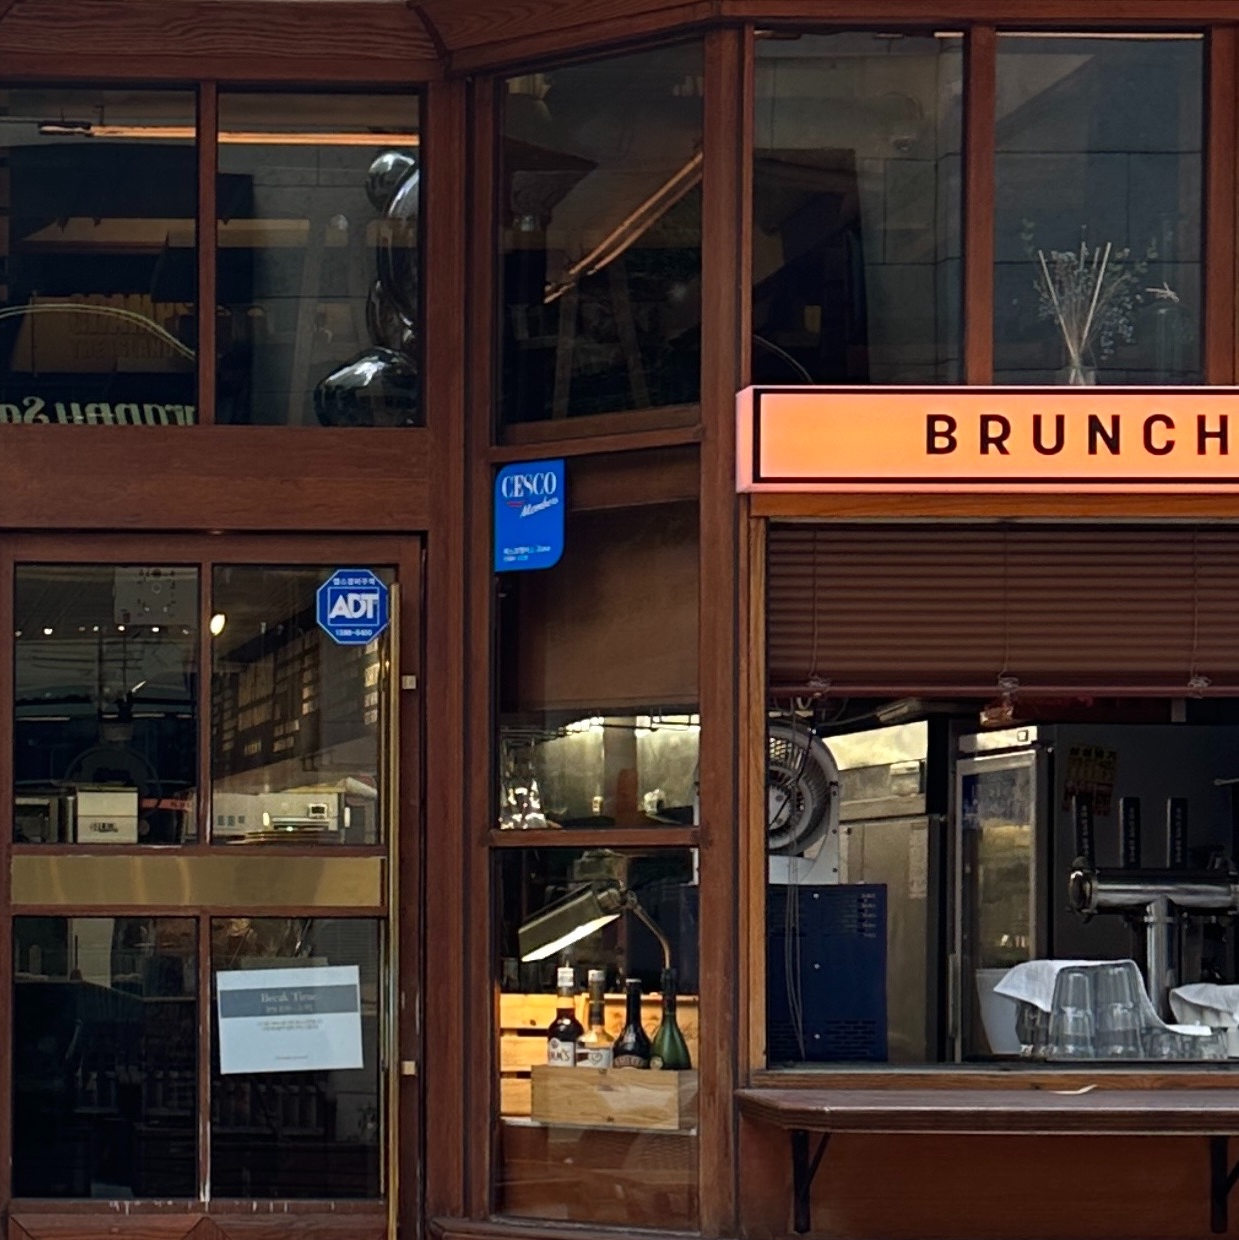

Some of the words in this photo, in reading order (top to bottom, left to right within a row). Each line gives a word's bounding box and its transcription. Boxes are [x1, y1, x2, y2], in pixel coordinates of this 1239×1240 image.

[925, 413, 1230, 456] BRUNCH
[501, 471, 558, 499] CESCO
[328, 593, 379, 619] ADT
